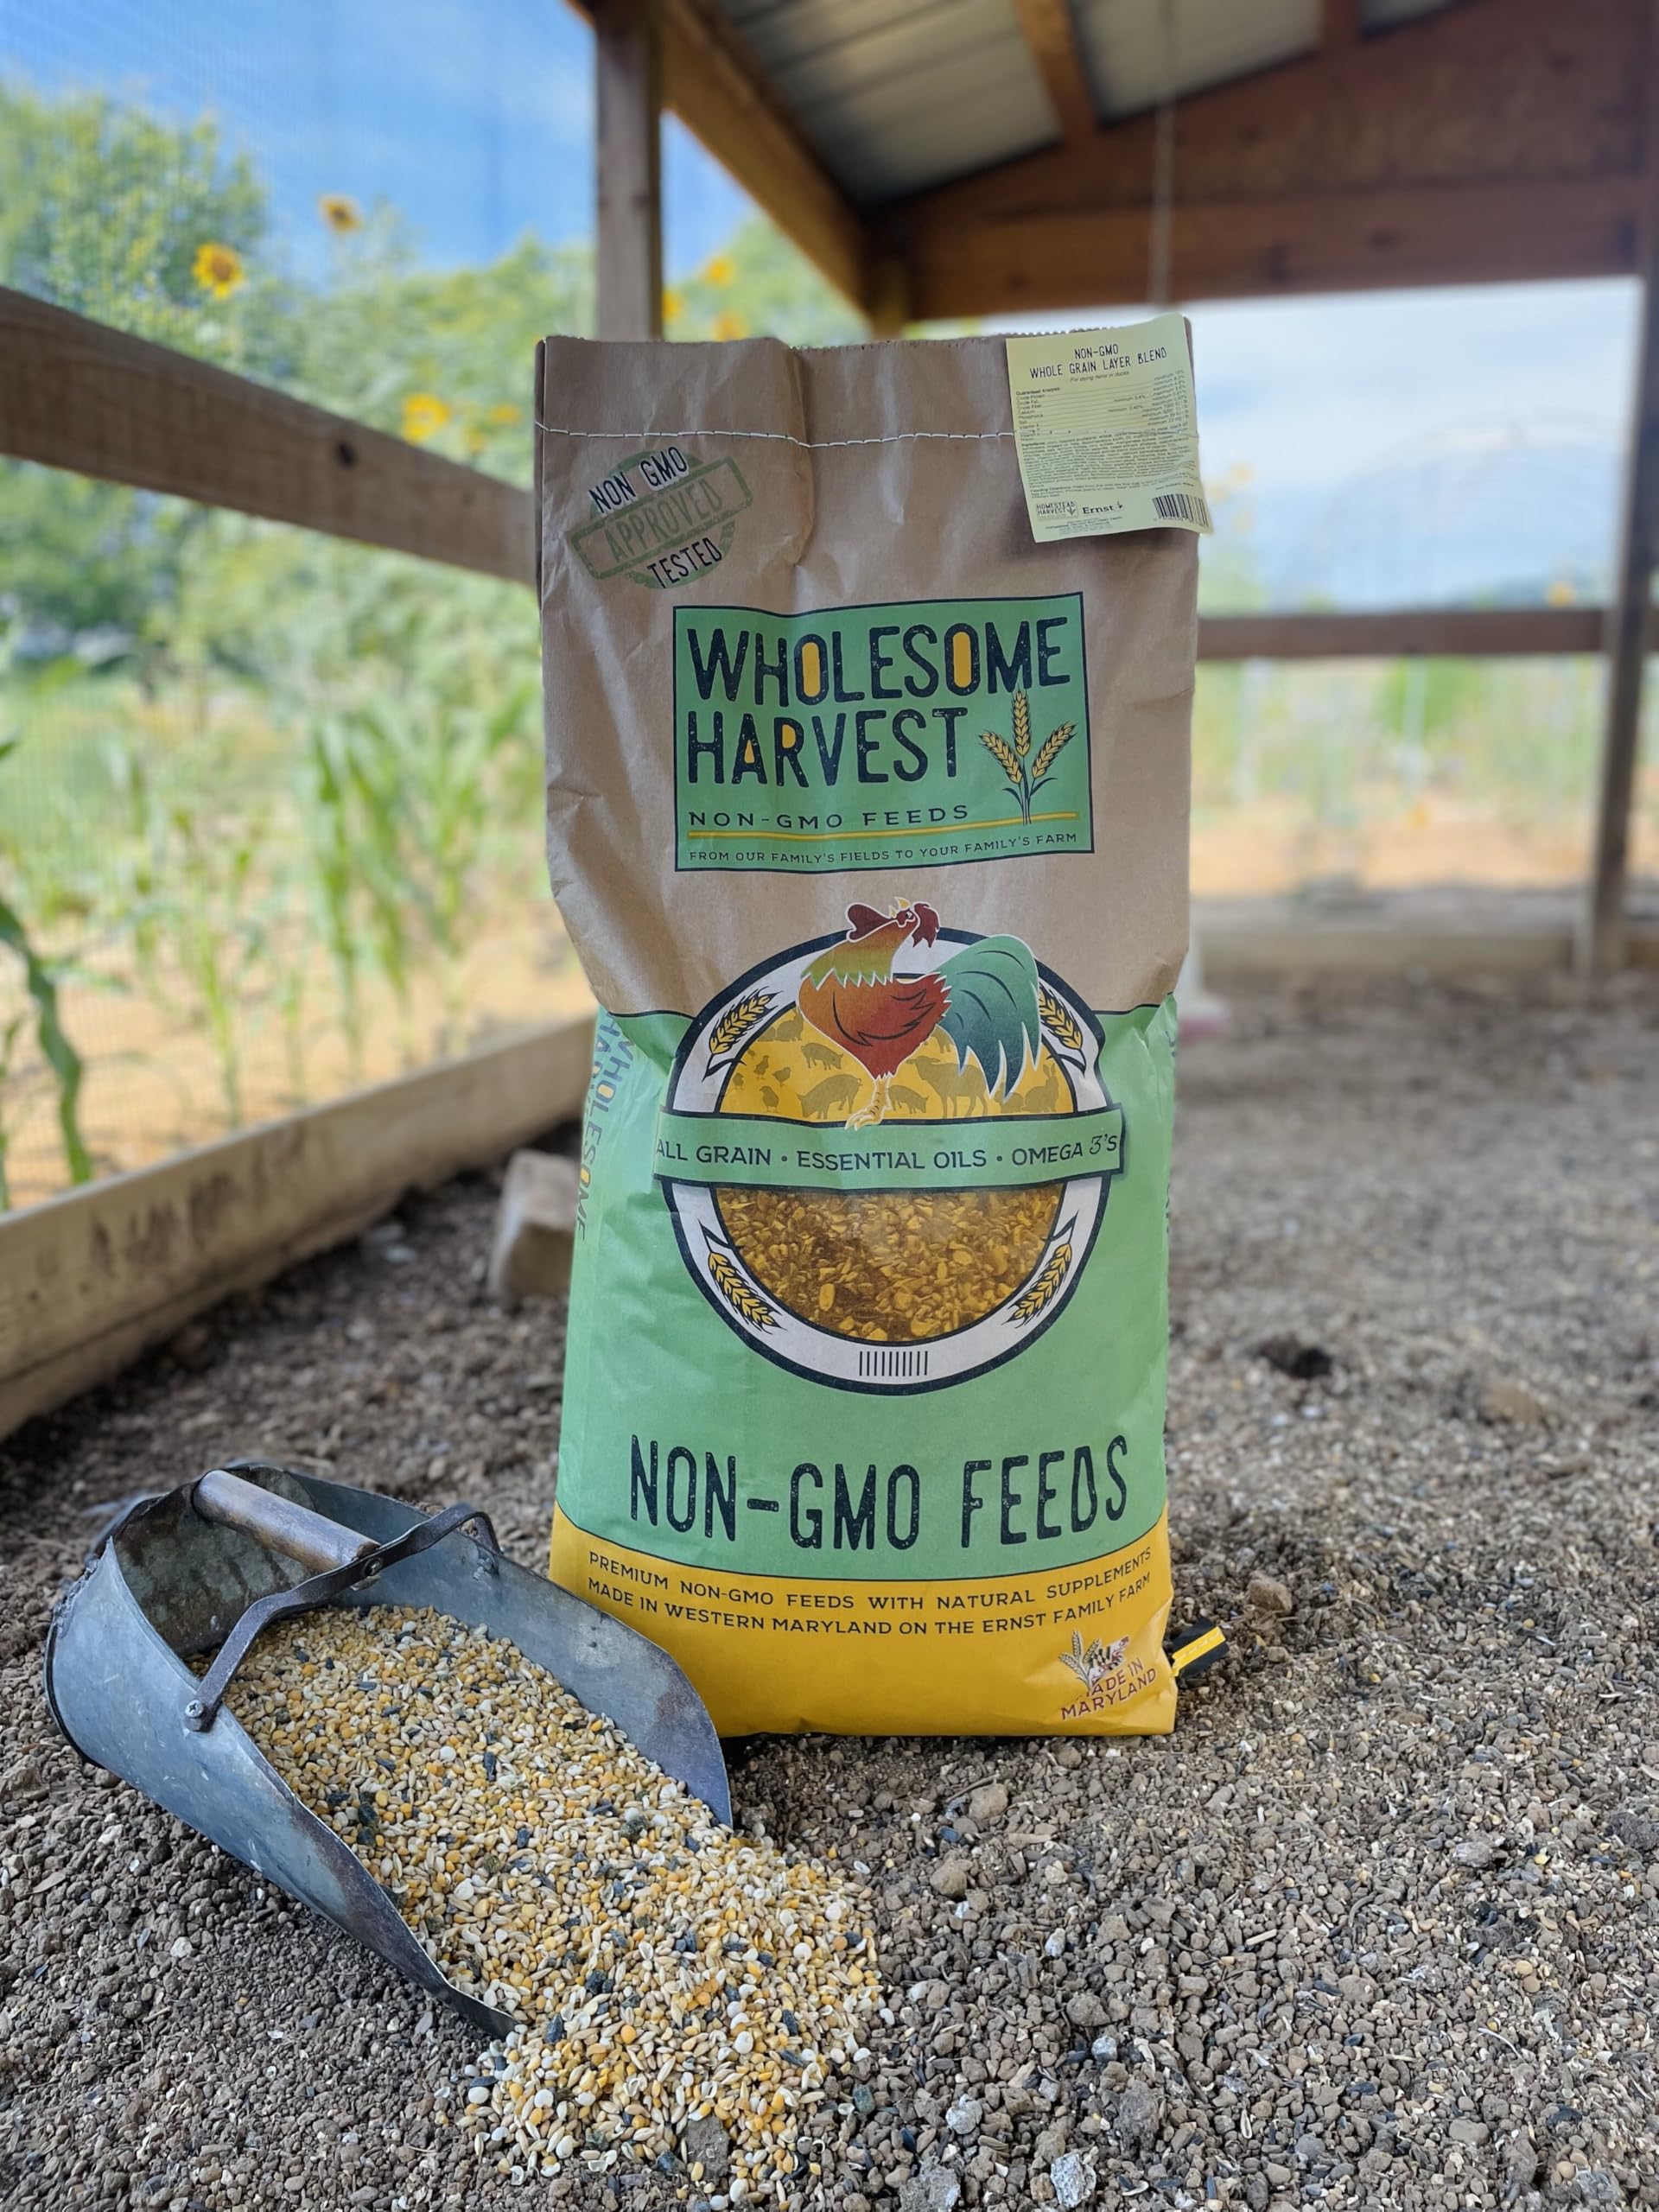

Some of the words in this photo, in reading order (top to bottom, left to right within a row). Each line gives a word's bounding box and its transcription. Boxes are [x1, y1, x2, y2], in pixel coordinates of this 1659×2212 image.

[1029, 364, 1063, 379] WHOLE
[1069, 360, 1097, 374] GRAIN
[1103, 356, 1131, 371] LAYER
[1137, 346, 1167, 365] BLEND
[1074, 343, 1119, 359] NON-GMO
[588, 472, 637, 513] NON
[640, 447, 688, 486] GMO
[1037, 501, 1075, 510] HOMESTEAD
[605, 478, 723, 563] APPROVED
[1082, 505, 1114, 515] Ernst
[646, 537, 722, 589] TESTED
[686, 616, 1071, 708] WHOLESOME
[687, 707, 968, 788] HARVEST
[688, 810, 843, 830] NON-GMO
[863, 804, 969, 827] FEEDS
[690, 851, 729, 862] FROM
[735, 851, 766, 862] OUR
[771, 851, 836, 865] FAMILY'S
[841, 850, 891, 862] FIELDS
[895, 849, 914, 860] TO
[918, 844, 959, 858] YOUR
[965, 835, 1031, 854] FAMILY'S
[1036, 832, 1077, 845] FARM
[656, 1138, 689, 1162] ALL
[696, 1145, 772, 1166] GRAIN
[797, 1149, 925, 1172] ESSENTIAL
[933, 1149, 987, 1168] OILS
[1011, 1142, 1084, 1166] OMEGA
[1089, 1133, 1118, 1155] 3'S
[630, 1433, 920, 1551] NON-GMO
[961, 1434, 1128, 1549] FEEDS
[588, 1577, 634, 1606] MADE
[639, 1597, 658, 1613] IN
[664, 1602, 765, 1630] WESTERN
[772, 1618, 892, 1635] MARYLAND
[899, 1622, 927, 1635] ON
[935, 1621, 975, 1634] THE
[982, 1613, 1046, 1633] ERNST
[1053, 1593, 1115, 1624] FAMILY
[1118, 1572, 1151, 1603] FARM
[589, 1551, 668, 1590] PREMIUM
[680, 1580, 774, 1605] NON-GMO
[787, 1593, 855, 1610] FEEDS
[868, 1595, 924, 1611] WITH
[937, 1589, 1035, 1611] NATURAL
[1046, 1547, 1152, 1599] SUPPLEMENTS
[1128, 1656, 1144, 1677] IN
[1060, 1668, 1157, 1721] MARYLAND
